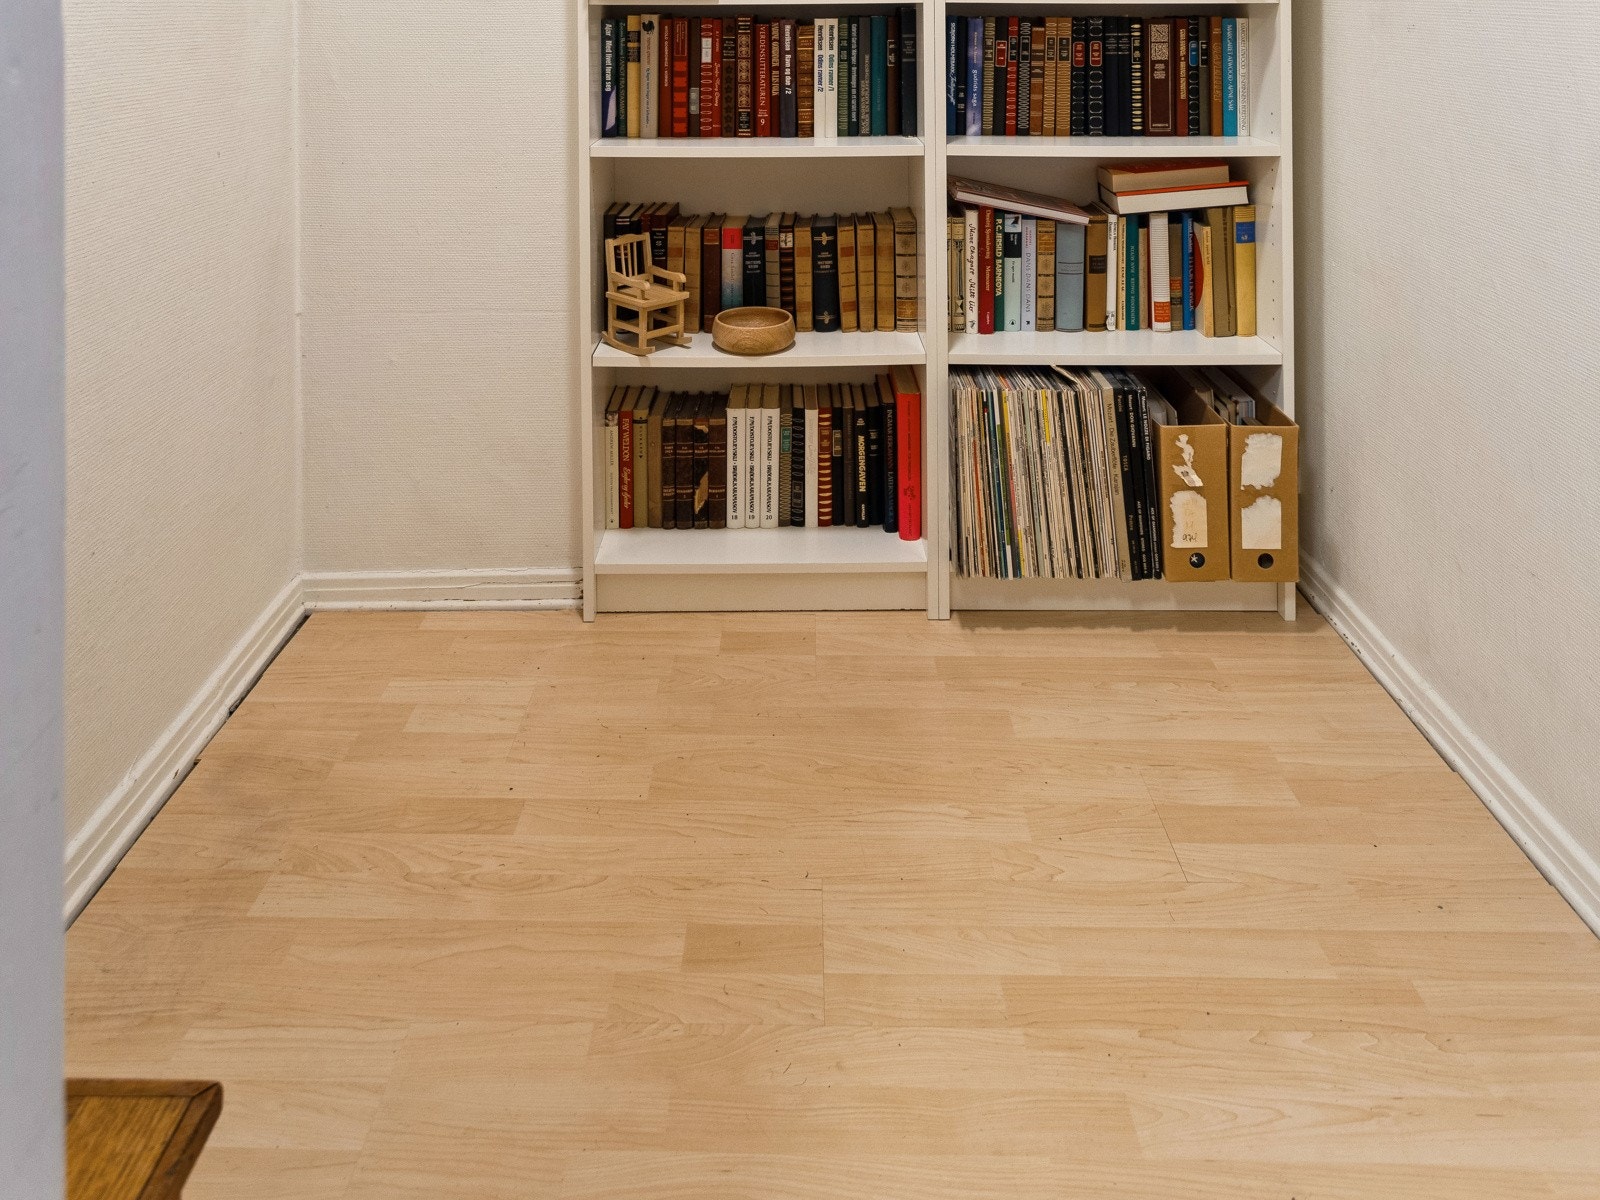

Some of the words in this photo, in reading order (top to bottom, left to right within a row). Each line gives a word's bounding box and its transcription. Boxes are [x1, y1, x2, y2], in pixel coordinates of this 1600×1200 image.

[604, 23, 612, 36] Ajar
[784, 24, 792, 51] Henriksen
[604, 40, 612, 53] Med
[604, 53, 612, 66] livet
[784, 54, 792, 68] Ravn
[604, 66, 612, 81] foran
[604, 81, 612, 92] seg
[784, 75, 792, 86] due
[760, 118, 765, 126] 9
[622, 418, 630, 430] FAY
[622, 430, 630, 462] WELDON
[1109, 435, 1118, 470] Zauberflöte
[857, 435, 866, 492] MORGENGAVEN
[1112, 473, 1120, 496] Karajan
